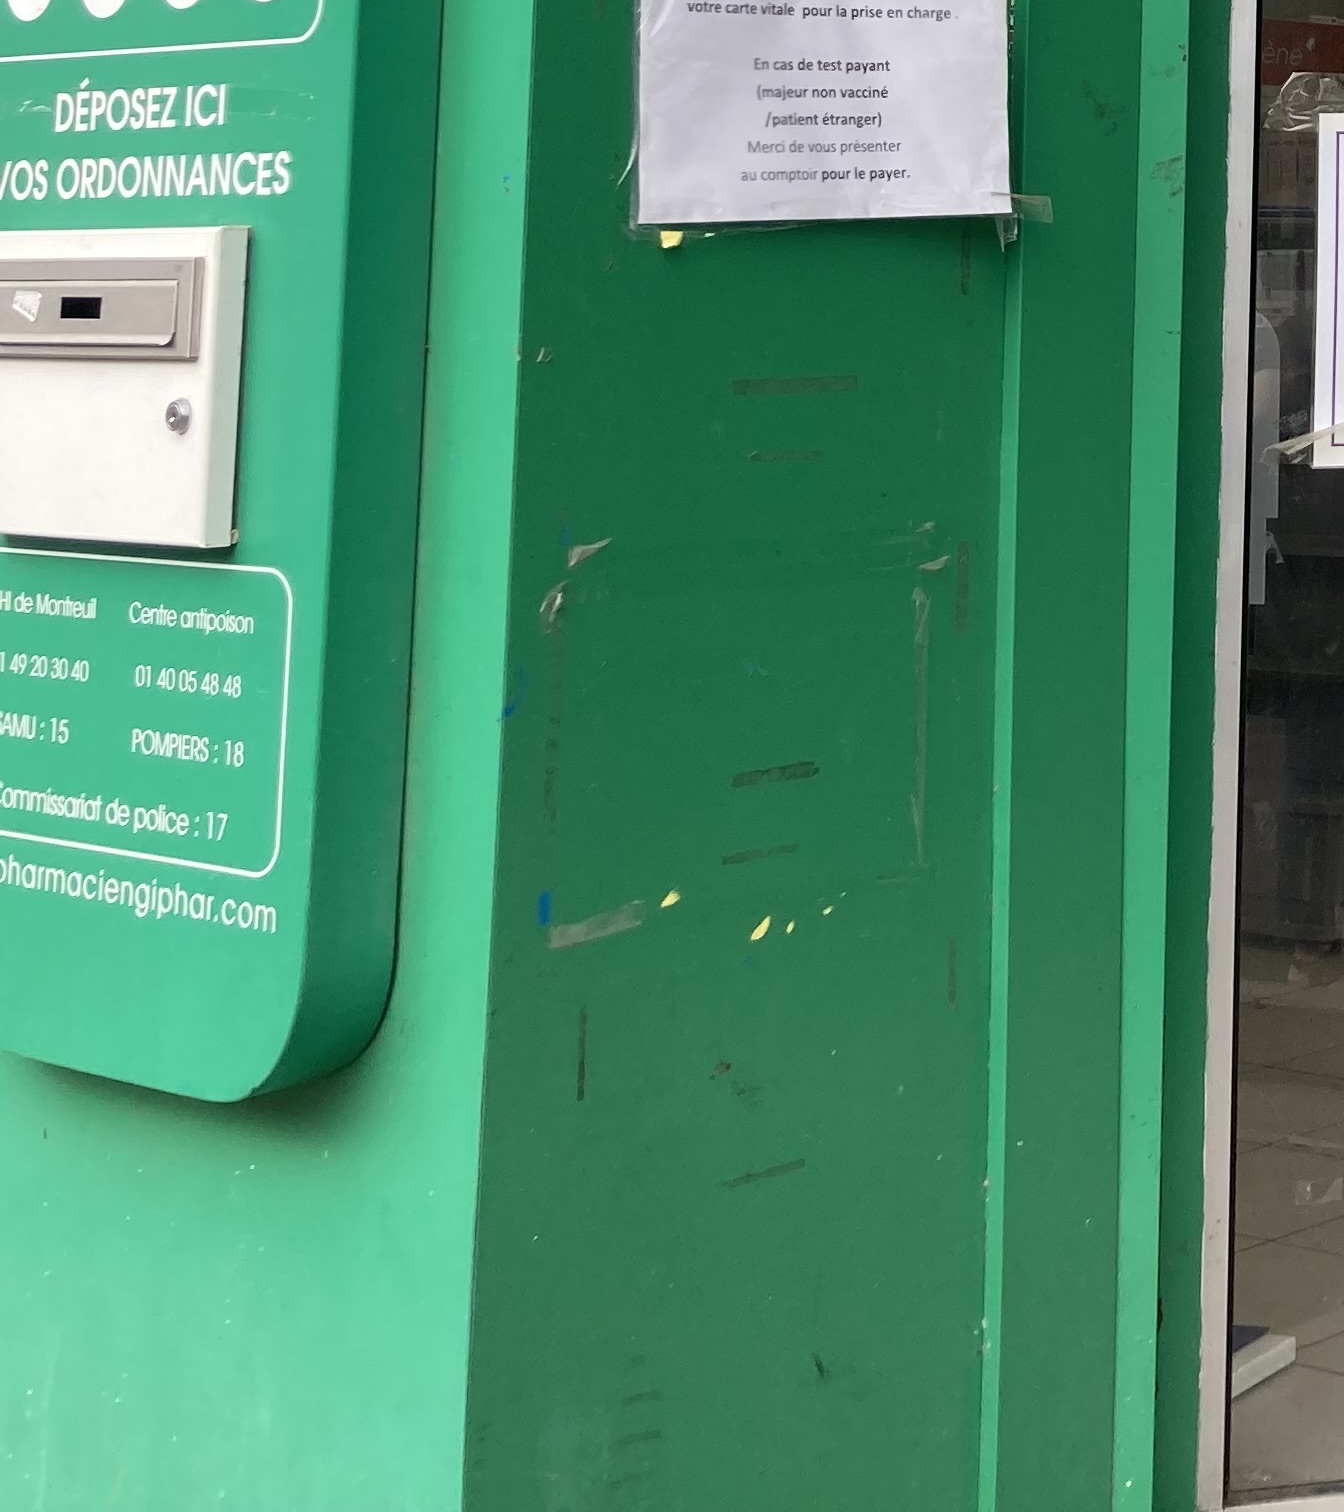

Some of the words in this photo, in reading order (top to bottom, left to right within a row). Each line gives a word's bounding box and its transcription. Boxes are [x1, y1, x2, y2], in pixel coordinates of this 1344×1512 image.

[753, 58, 770, 72] En
[773, 59, 794, 72] cas
[797, 58, 814, 72] de
[817, 58, 843, 72] test
[845, 59, 891, 76] payant
[55, 77, 177, 133] DÉPOSEZ
[185, 84, 226, 127] ICI
[129, 602, 177, 626] Centre
[180, 610, 254, 635] antipoison
